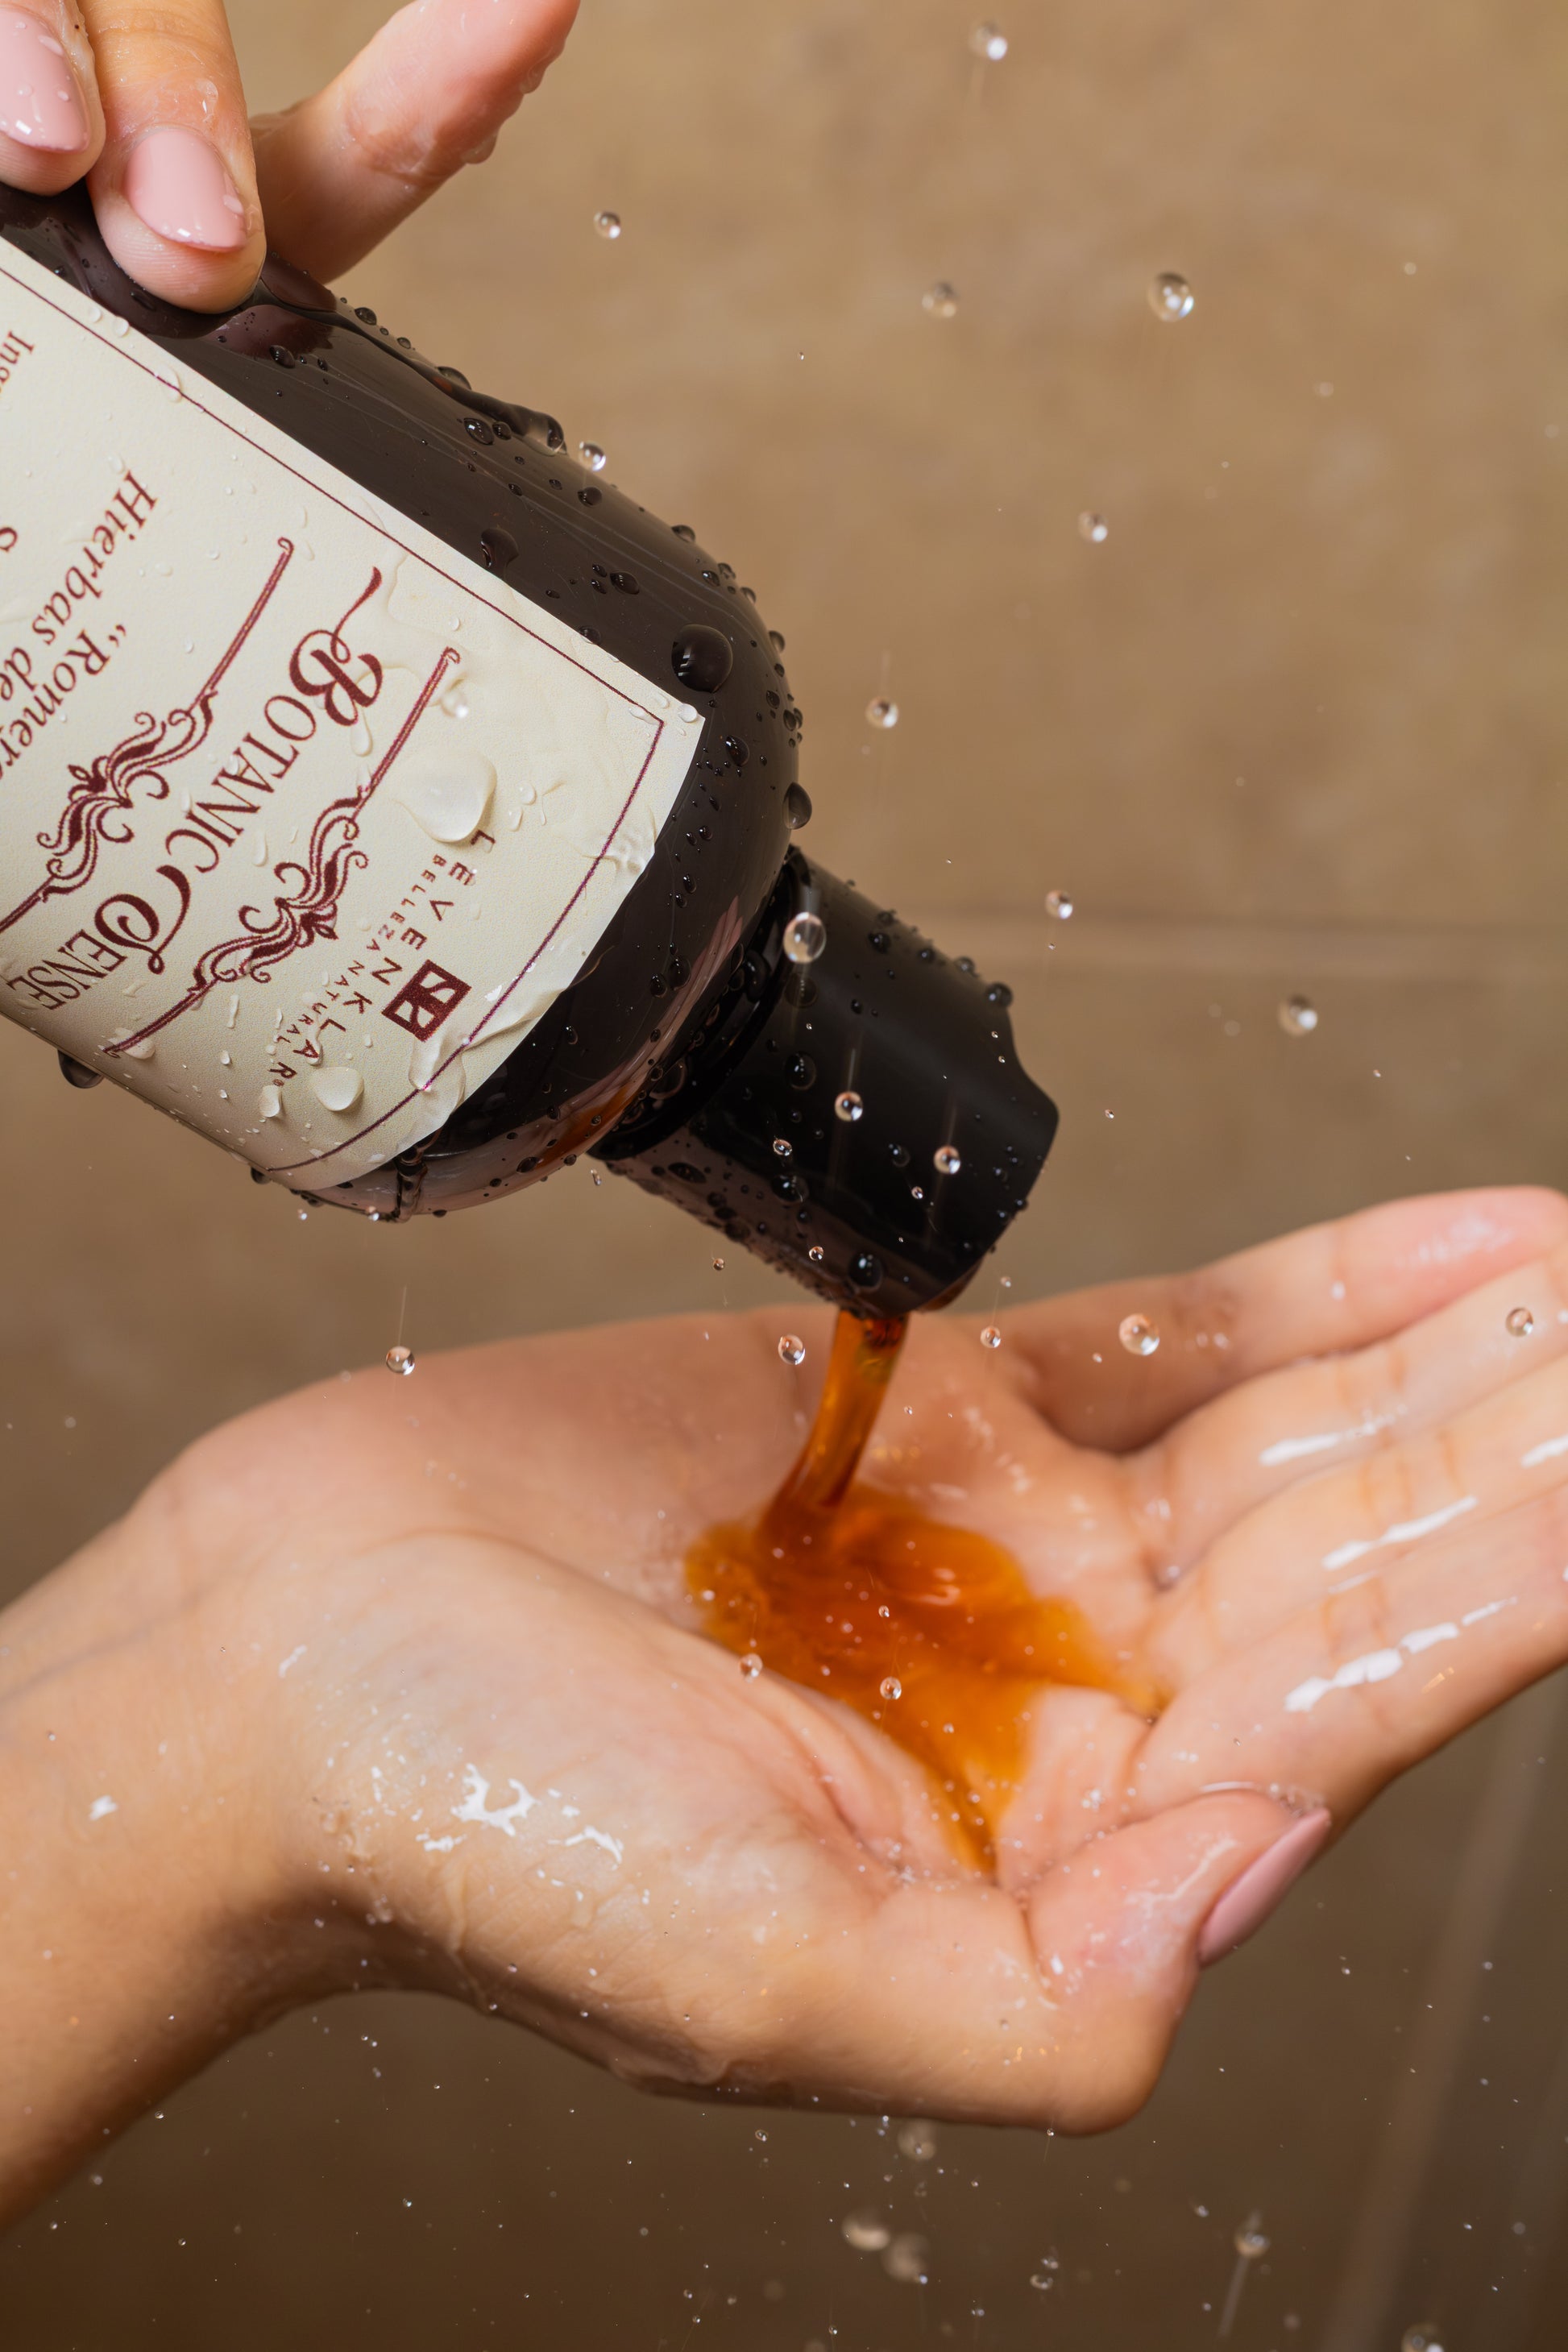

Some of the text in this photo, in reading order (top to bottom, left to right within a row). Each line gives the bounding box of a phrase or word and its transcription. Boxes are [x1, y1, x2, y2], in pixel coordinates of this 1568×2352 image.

[0, 470, 159, 702] Hierbas de
[0, 624, 127, 780] “Romer
[6, 566, 383, 1010] BOTANIC SENSE
[276, 853, 447, 1043] BELLEZA NATURAL
